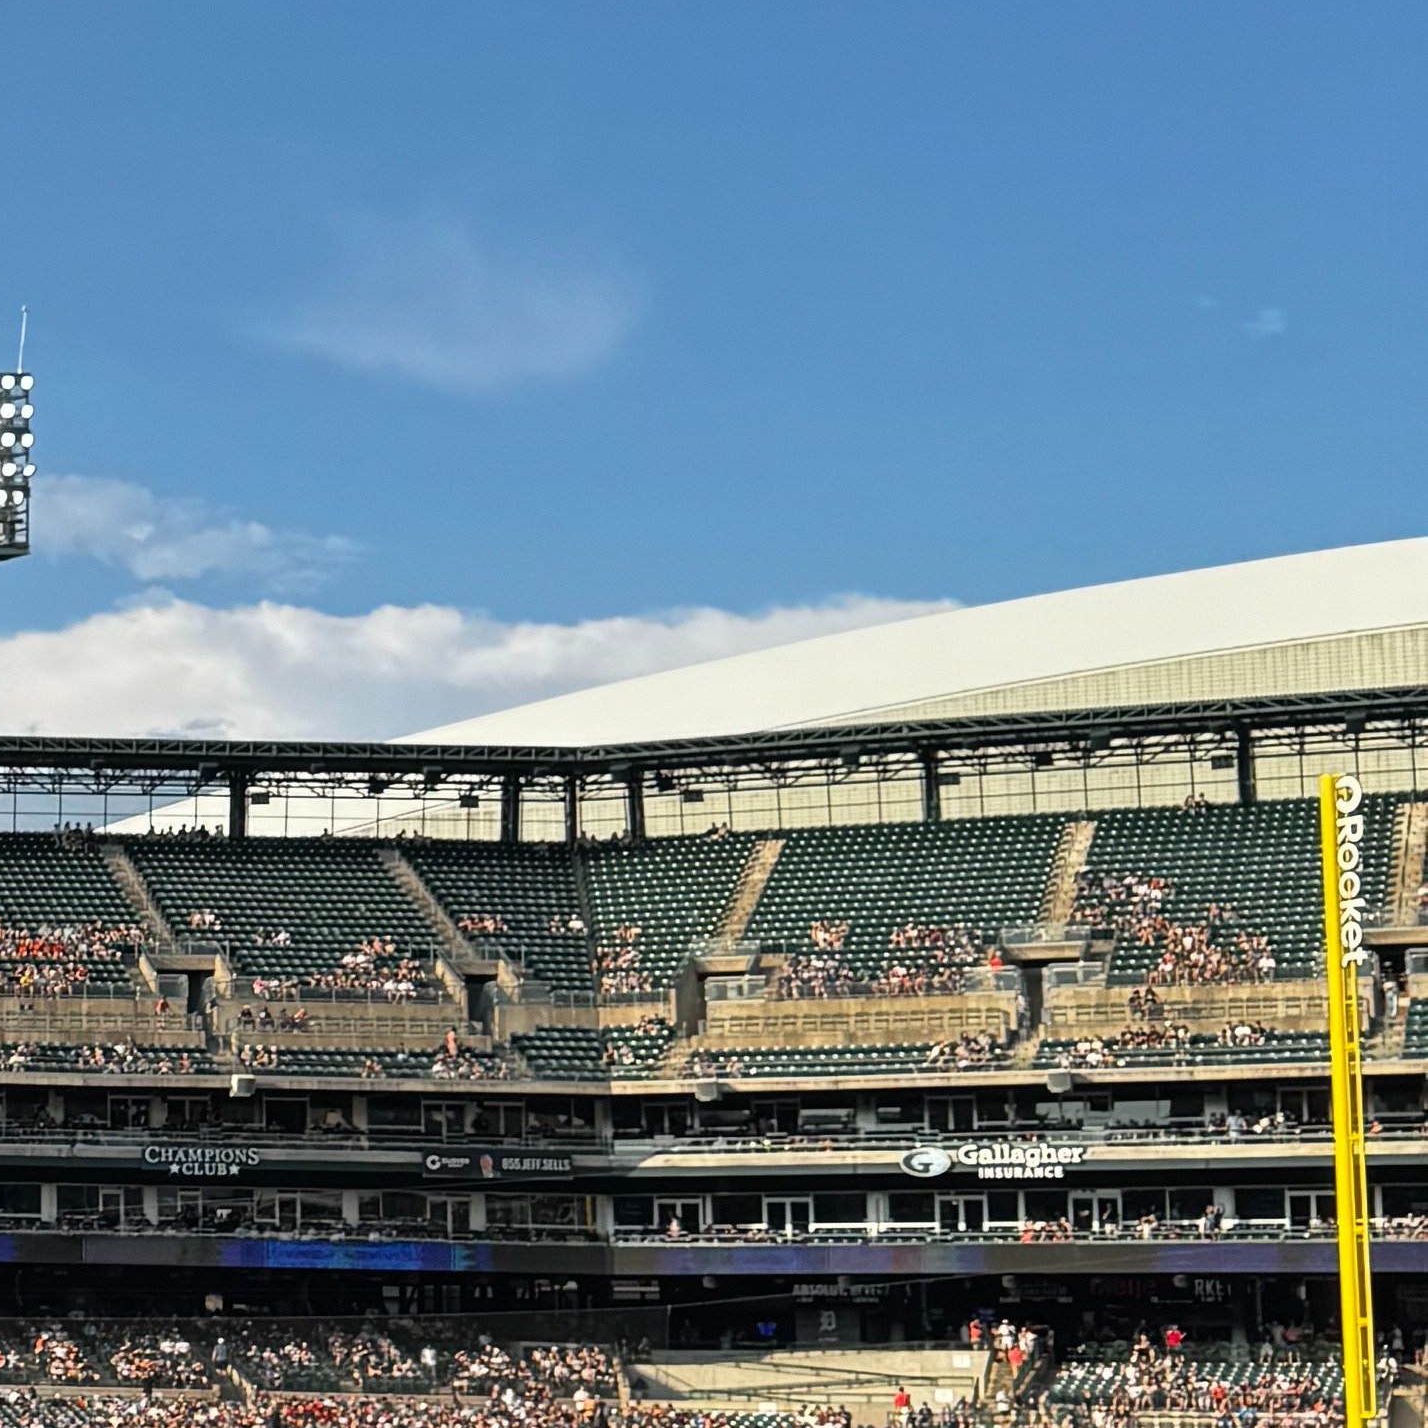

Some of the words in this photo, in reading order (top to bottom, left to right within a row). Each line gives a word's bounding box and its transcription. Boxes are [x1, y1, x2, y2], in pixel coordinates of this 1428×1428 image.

[1337, 814, 1368, 968] Rocket
[144, 1146, 260, 1165] CHAMPIONS
[958, 1144, 1084, 1167] Gallagher
[182, 1163, 228, 1175] CLUB
[978, 1166, 1064, 1179] INSURANCE
